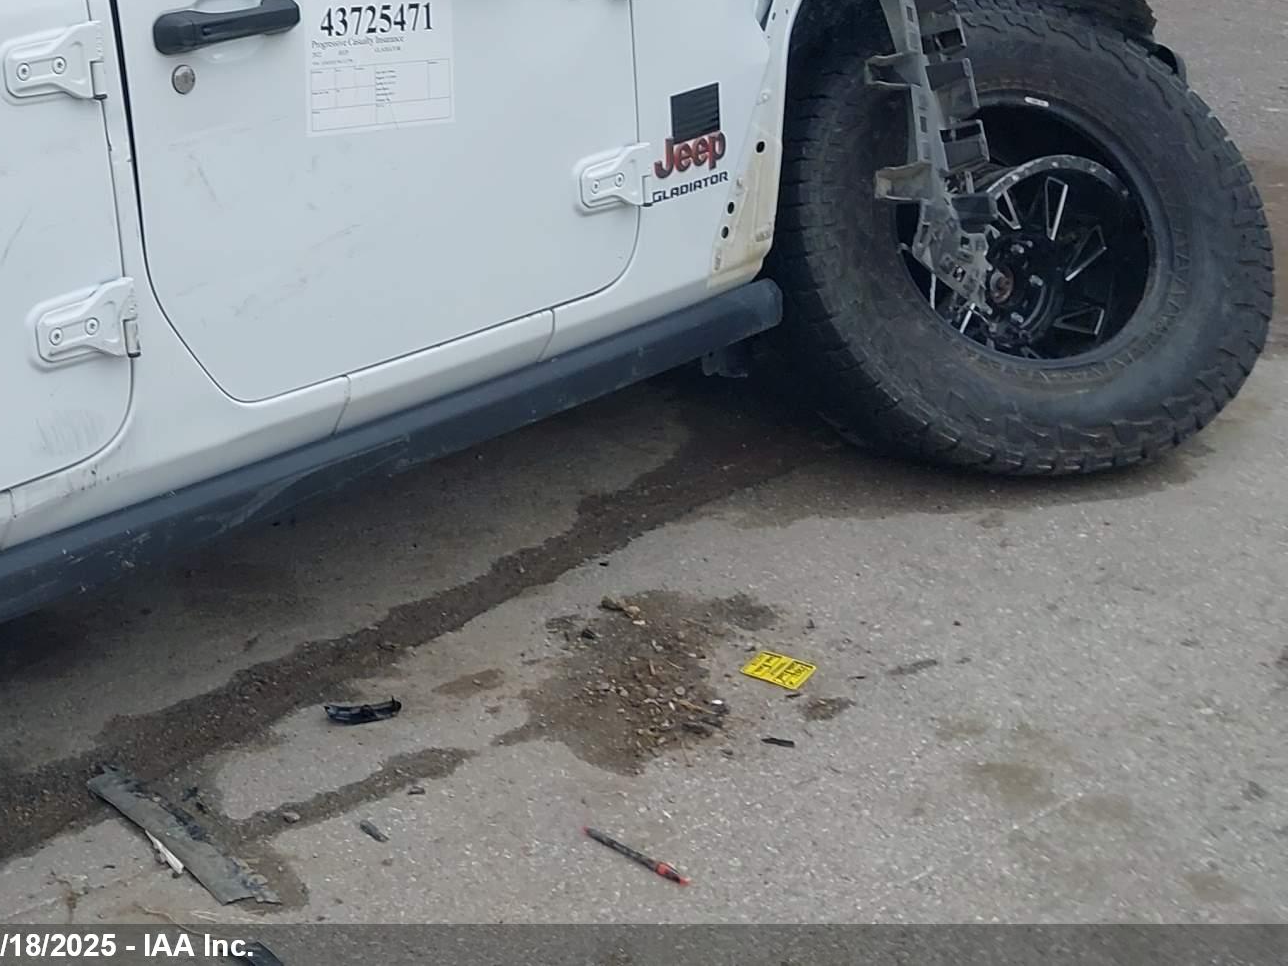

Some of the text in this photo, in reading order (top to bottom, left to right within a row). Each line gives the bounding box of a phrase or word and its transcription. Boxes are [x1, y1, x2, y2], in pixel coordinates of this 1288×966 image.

[320, 2, 433, 37] 43725471
[654, 130, 726, 179] Jeep
[652, 171, 729, 204] GLADIATOR
